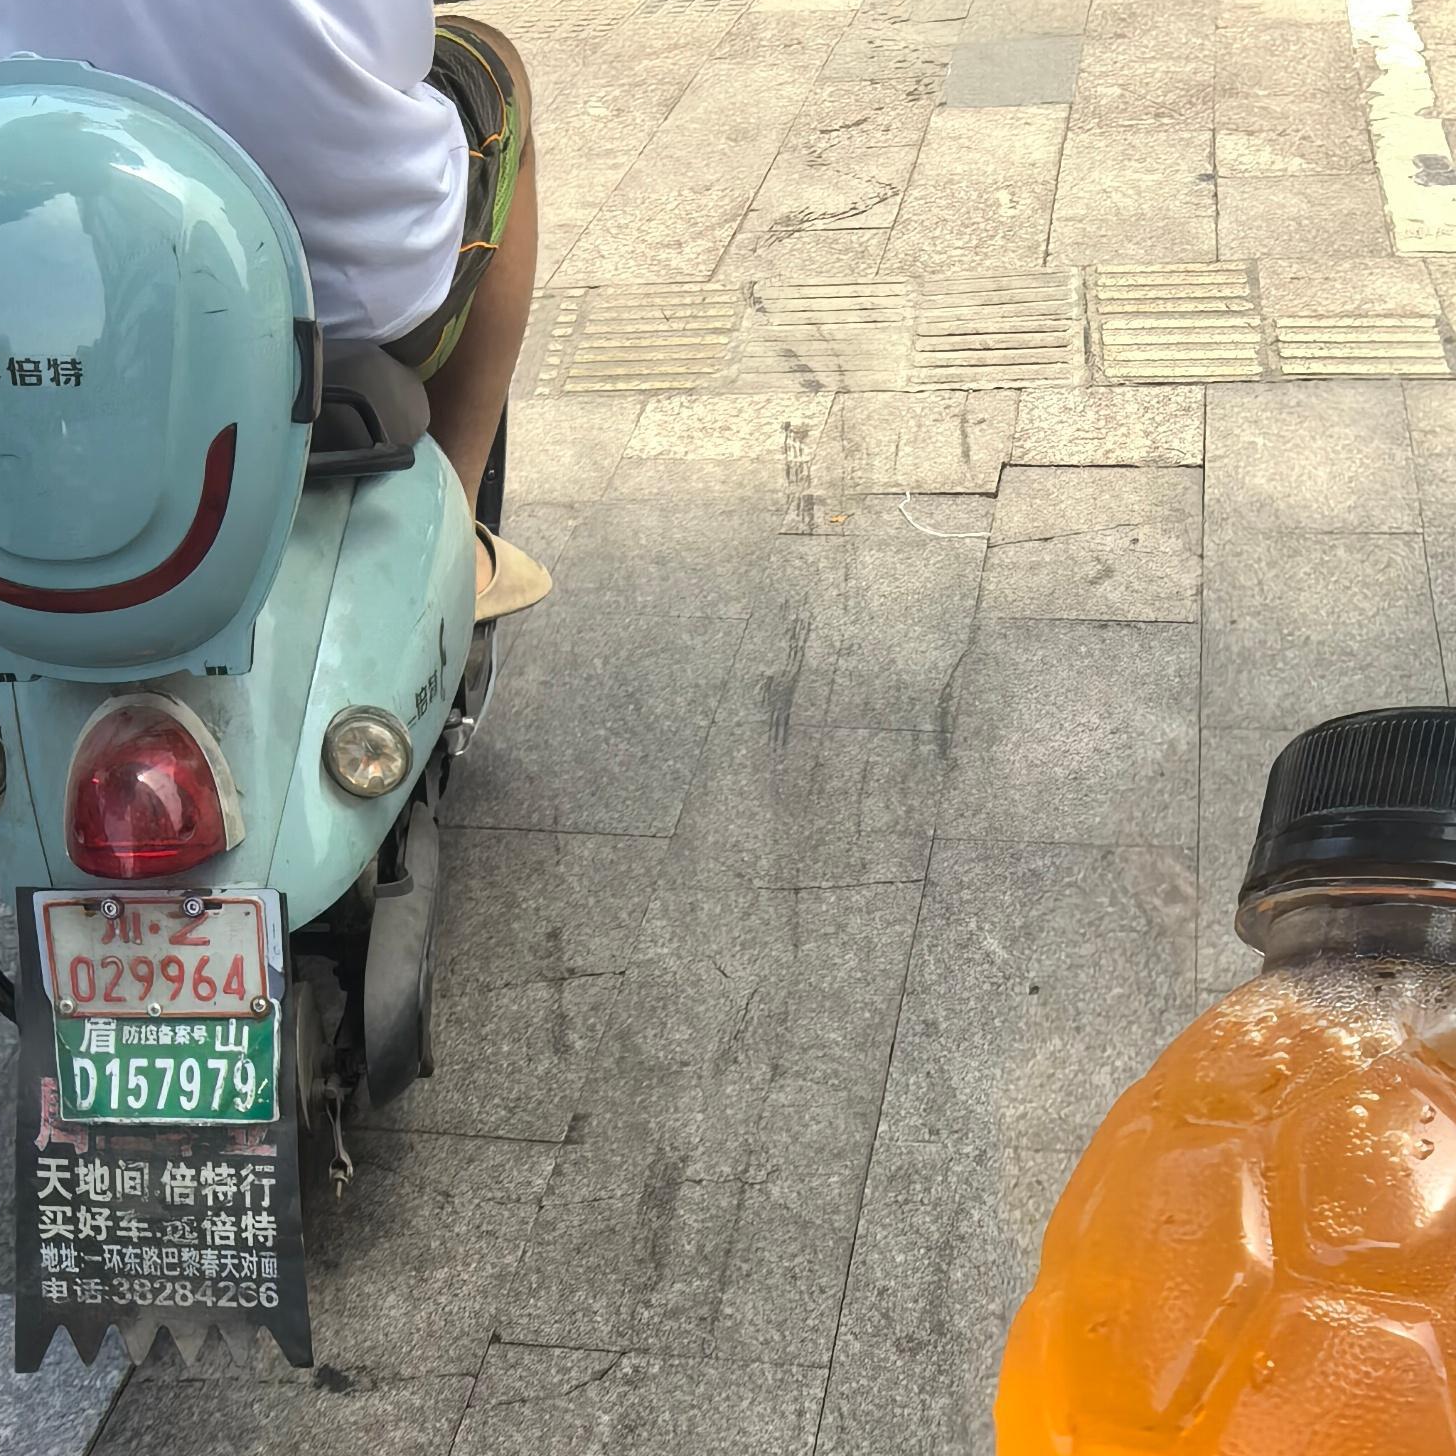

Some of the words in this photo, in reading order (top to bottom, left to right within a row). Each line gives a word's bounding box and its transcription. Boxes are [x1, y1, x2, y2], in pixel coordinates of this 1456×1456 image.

[6, 356, 84, 388] 倍特
[69, 953, 246, 1003] 029964
[80, 1018, 117, 1054] 眉
[214, 1019, 250, 1055] 山
[73, 1057, 257, 1112] D157979
